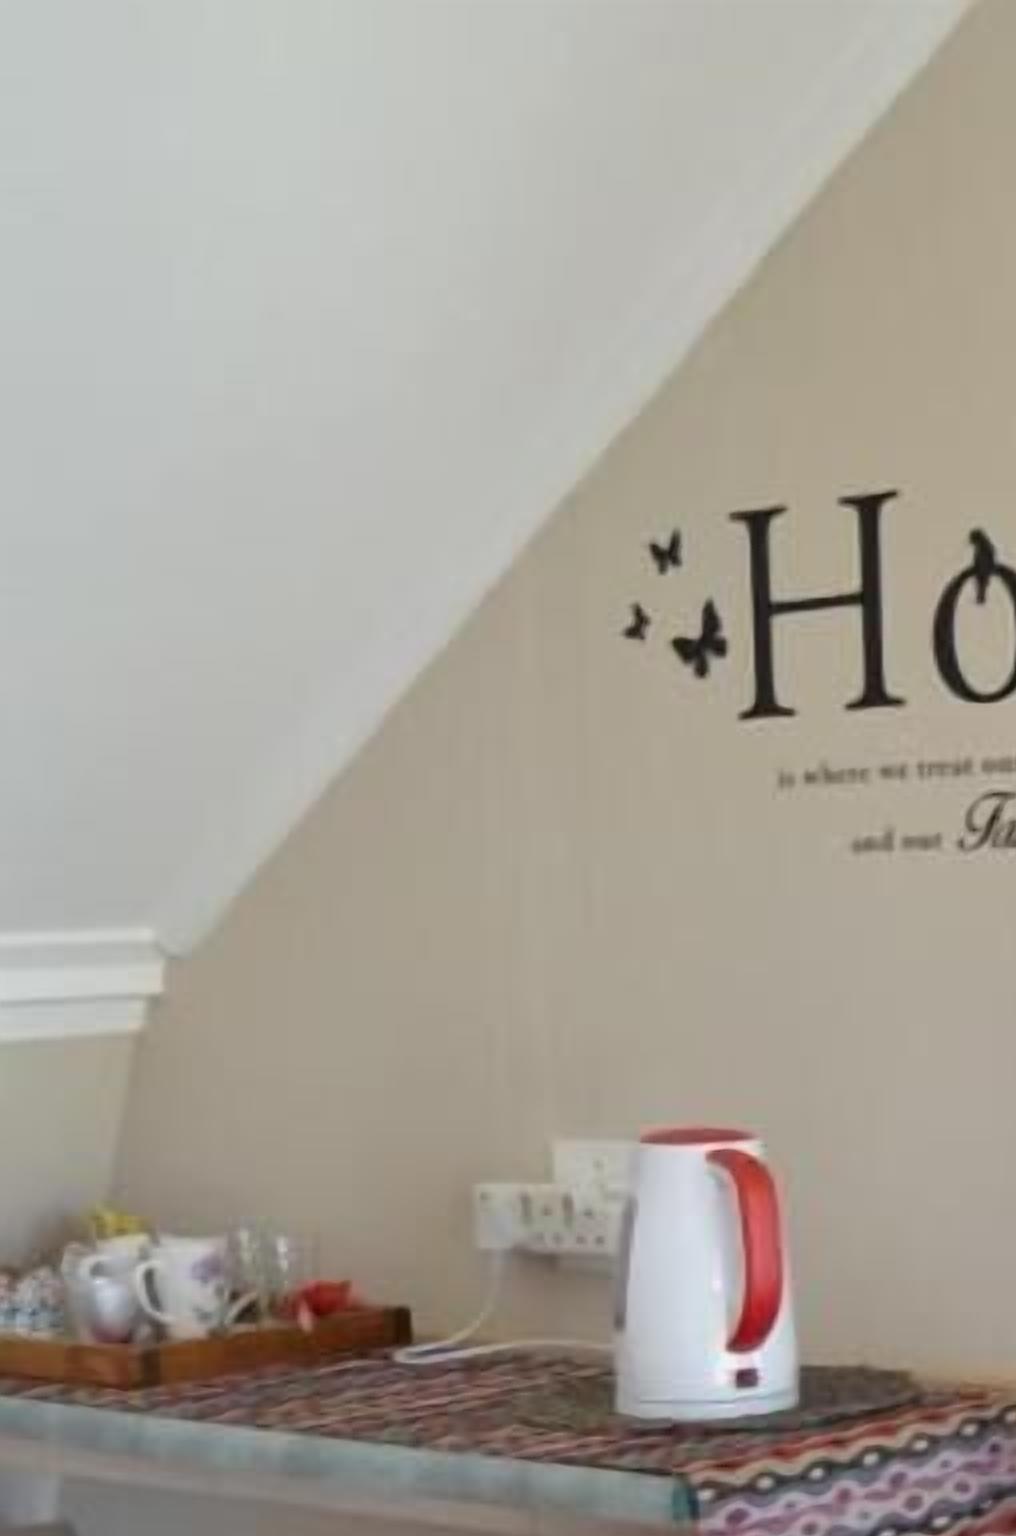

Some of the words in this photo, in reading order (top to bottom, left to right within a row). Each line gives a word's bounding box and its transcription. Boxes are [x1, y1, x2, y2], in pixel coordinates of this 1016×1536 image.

[804, 760, 869, 785] where
[879, 763, 908, 780] we
[916, 757, 973, 779] treat
